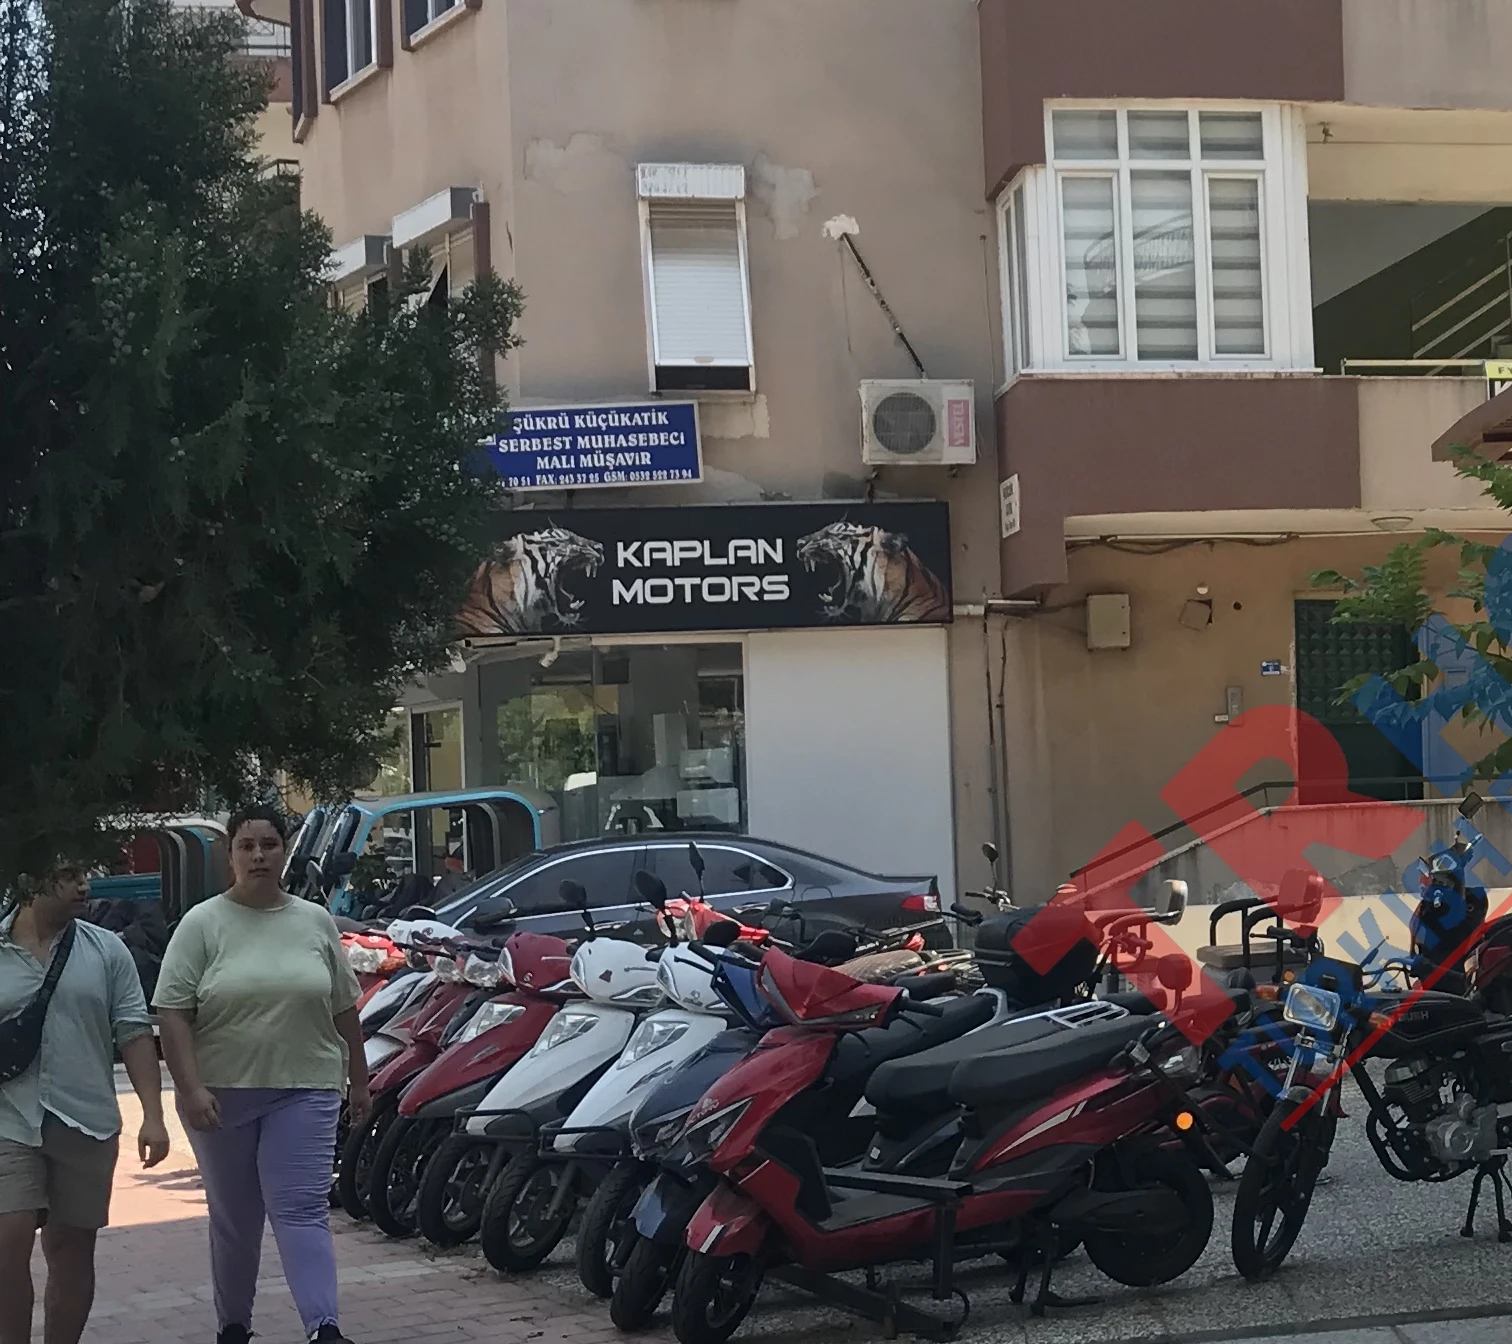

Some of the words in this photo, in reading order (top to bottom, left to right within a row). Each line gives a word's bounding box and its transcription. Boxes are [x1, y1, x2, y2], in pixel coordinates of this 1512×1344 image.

[512, 412, 570, 435] ŞÜKRÜ
[574, 408, 670, 431] KÜÇÜKATİK
[498, 436, 573, 453] SERBEST
[616, 538, 784, 568] KAPLAN
[612, 574, 790, 605] MOTORS
